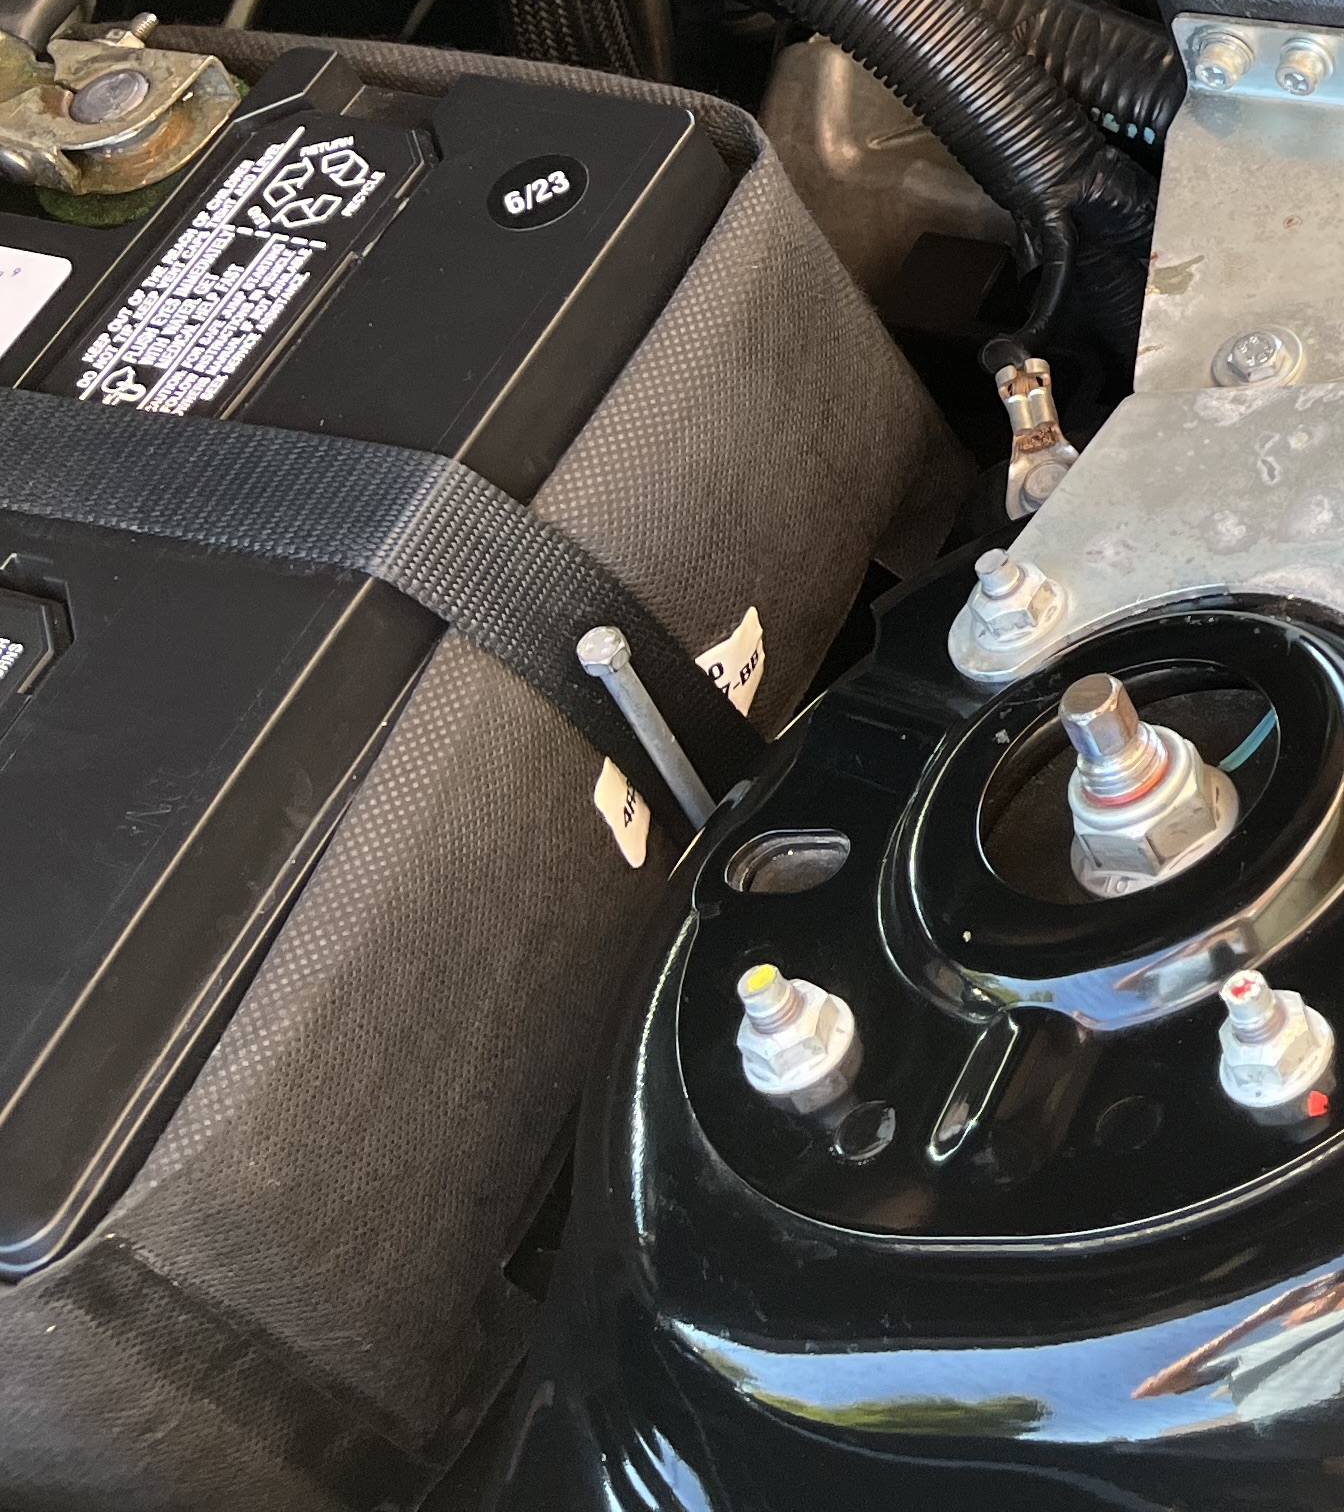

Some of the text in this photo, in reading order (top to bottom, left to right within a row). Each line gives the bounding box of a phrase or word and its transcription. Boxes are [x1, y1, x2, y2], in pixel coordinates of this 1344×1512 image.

[299, 135, 354, 158] RETURN
[340, 170, 387, 218] RECYCLE
[504, 170, 570, 214] 6/23
[74, 369, 99, 388] DO
[90, 344, 120, 368] NOT
[129, 290, 163, 319] KEEP
[154, 259, 188, 289] VENT
[178, 229, 212, 259] CAPS
[203, 197, 238, 229] TIGHT
[230, 172, 258, 196] AND
[249, 141, 285, 172] LEVEL
[80, 331, 115, 362] KEEP
[104, 306, 135, 332] OUT
[124, 288, 150, 306] OF
[139, 263, 170, 288] THE
[159, 227, 200, 264] REACH
[189, 210, 214, 227] OF
[255, 248, 298, 288] VEHICLE
[263, 247, 315, 297] AVAILABLE
[120, 229, 239, 362] FLUSH EYES IMMEDIATELY
[136, 336, 172, 365] WITH
[190, 272, 222, 295] GET
[151, 263, 247, 368] MEDICAL HELP FAST
[178, 345, 207, 368] FOR
[196, 319, 227, 345] SAFE
[217, 290, 251, 318] JUMP
[238, 242, 289, 290] STARTING
[246, 288, 266, 301] IN
[246, 297, 275, 320] NOT
[238, 319, 257, 331] IF
[197, 373, 230, 400] SEEK
[218, 332, 263, 373] SERVICE
